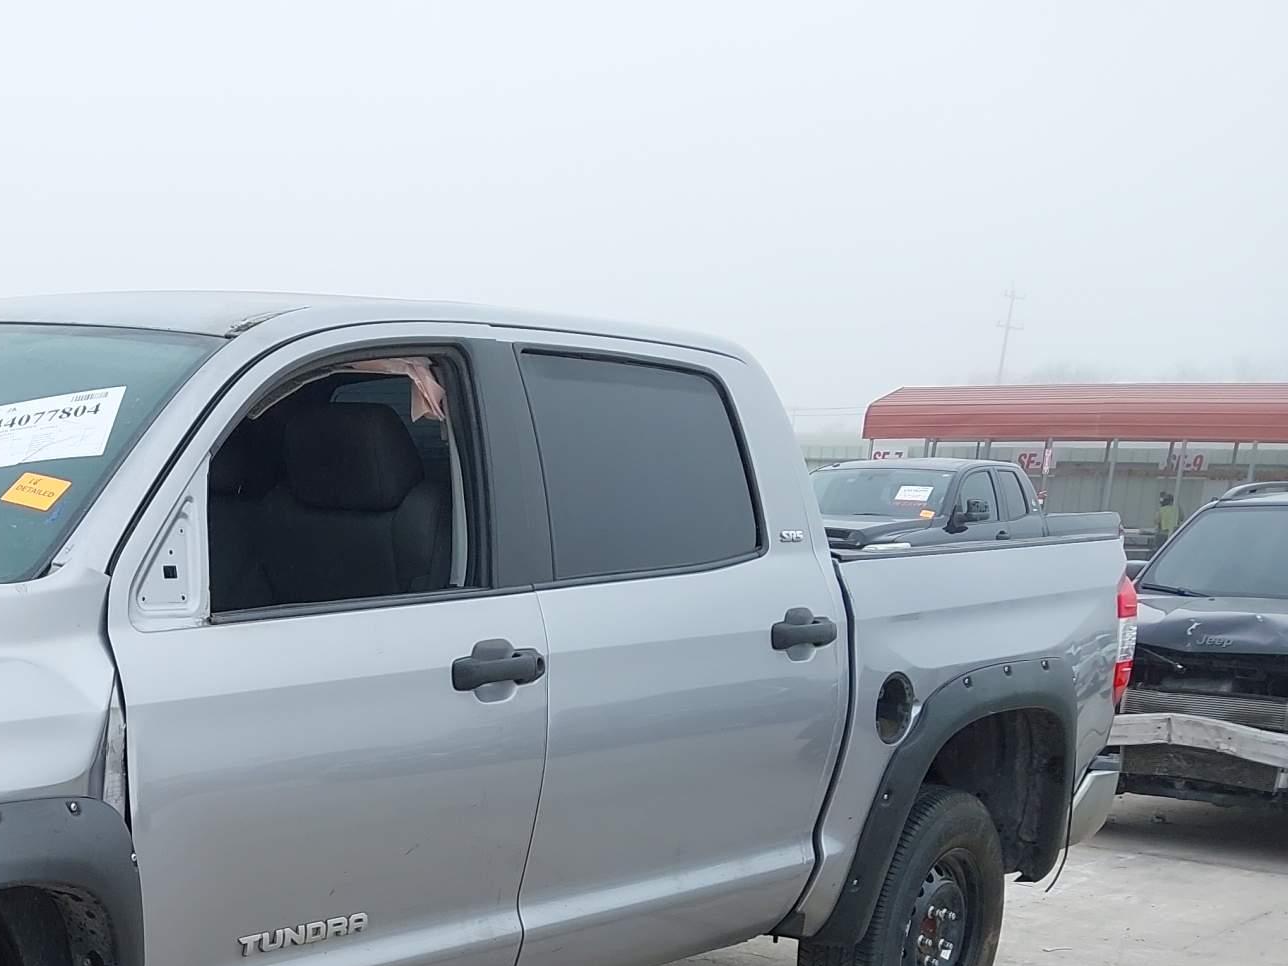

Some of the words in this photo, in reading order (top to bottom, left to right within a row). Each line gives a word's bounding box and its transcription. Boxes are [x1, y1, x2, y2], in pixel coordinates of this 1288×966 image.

[873, 451, 904, 460] SE7
[15, 484, 55, 498] DETAILED
[1196, 633, 1234, 648] Jeep
[237, 911, 369, 957] TUNDRA
